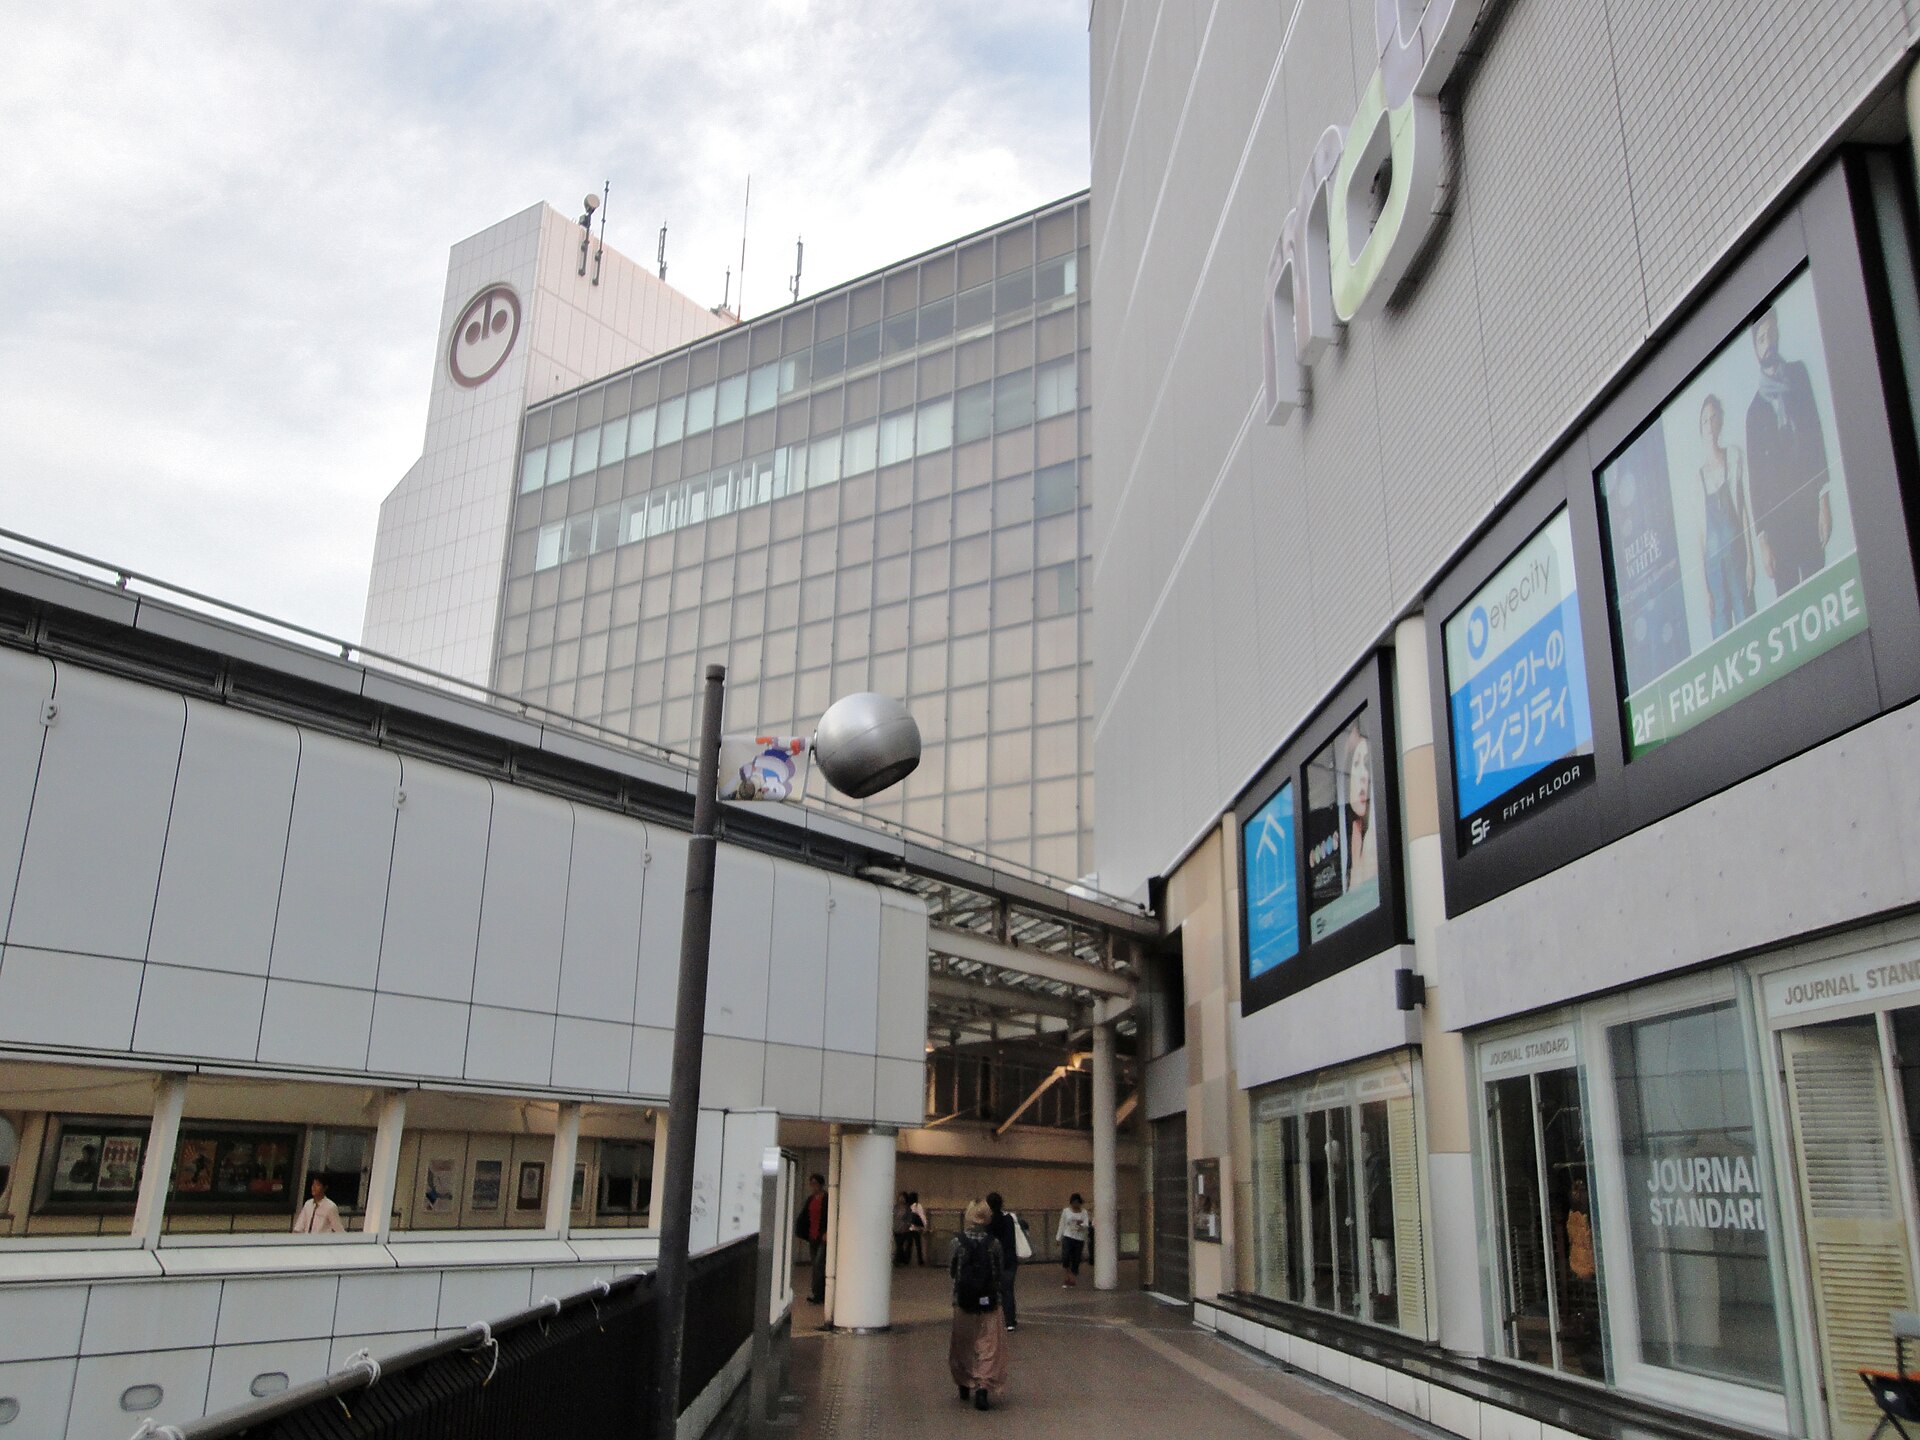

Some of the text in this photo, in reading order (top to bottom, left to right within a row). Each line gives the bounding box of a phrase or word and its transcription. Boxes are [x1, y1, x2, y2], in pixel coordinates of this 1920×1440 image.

[1490, 556, 1551, 631] eyecity
[1469, 629, 1564, 732] コンタクトの
[1633, 702, 1656, 746] 2F
[1669, 640, 1762, 723] FREAK'S
[1767, 578, 1860, 664] STORE
[1472, 686, 1567, 785] アイシティ
[1503, 795, 1535, 821] FIFTH
[1539, 764, 1581, 799] FLOOR
[1785, 973, 1860, 1005] JOURNAL
[1490, 1037, 1569, 1066] JOURNAL STANDARD
